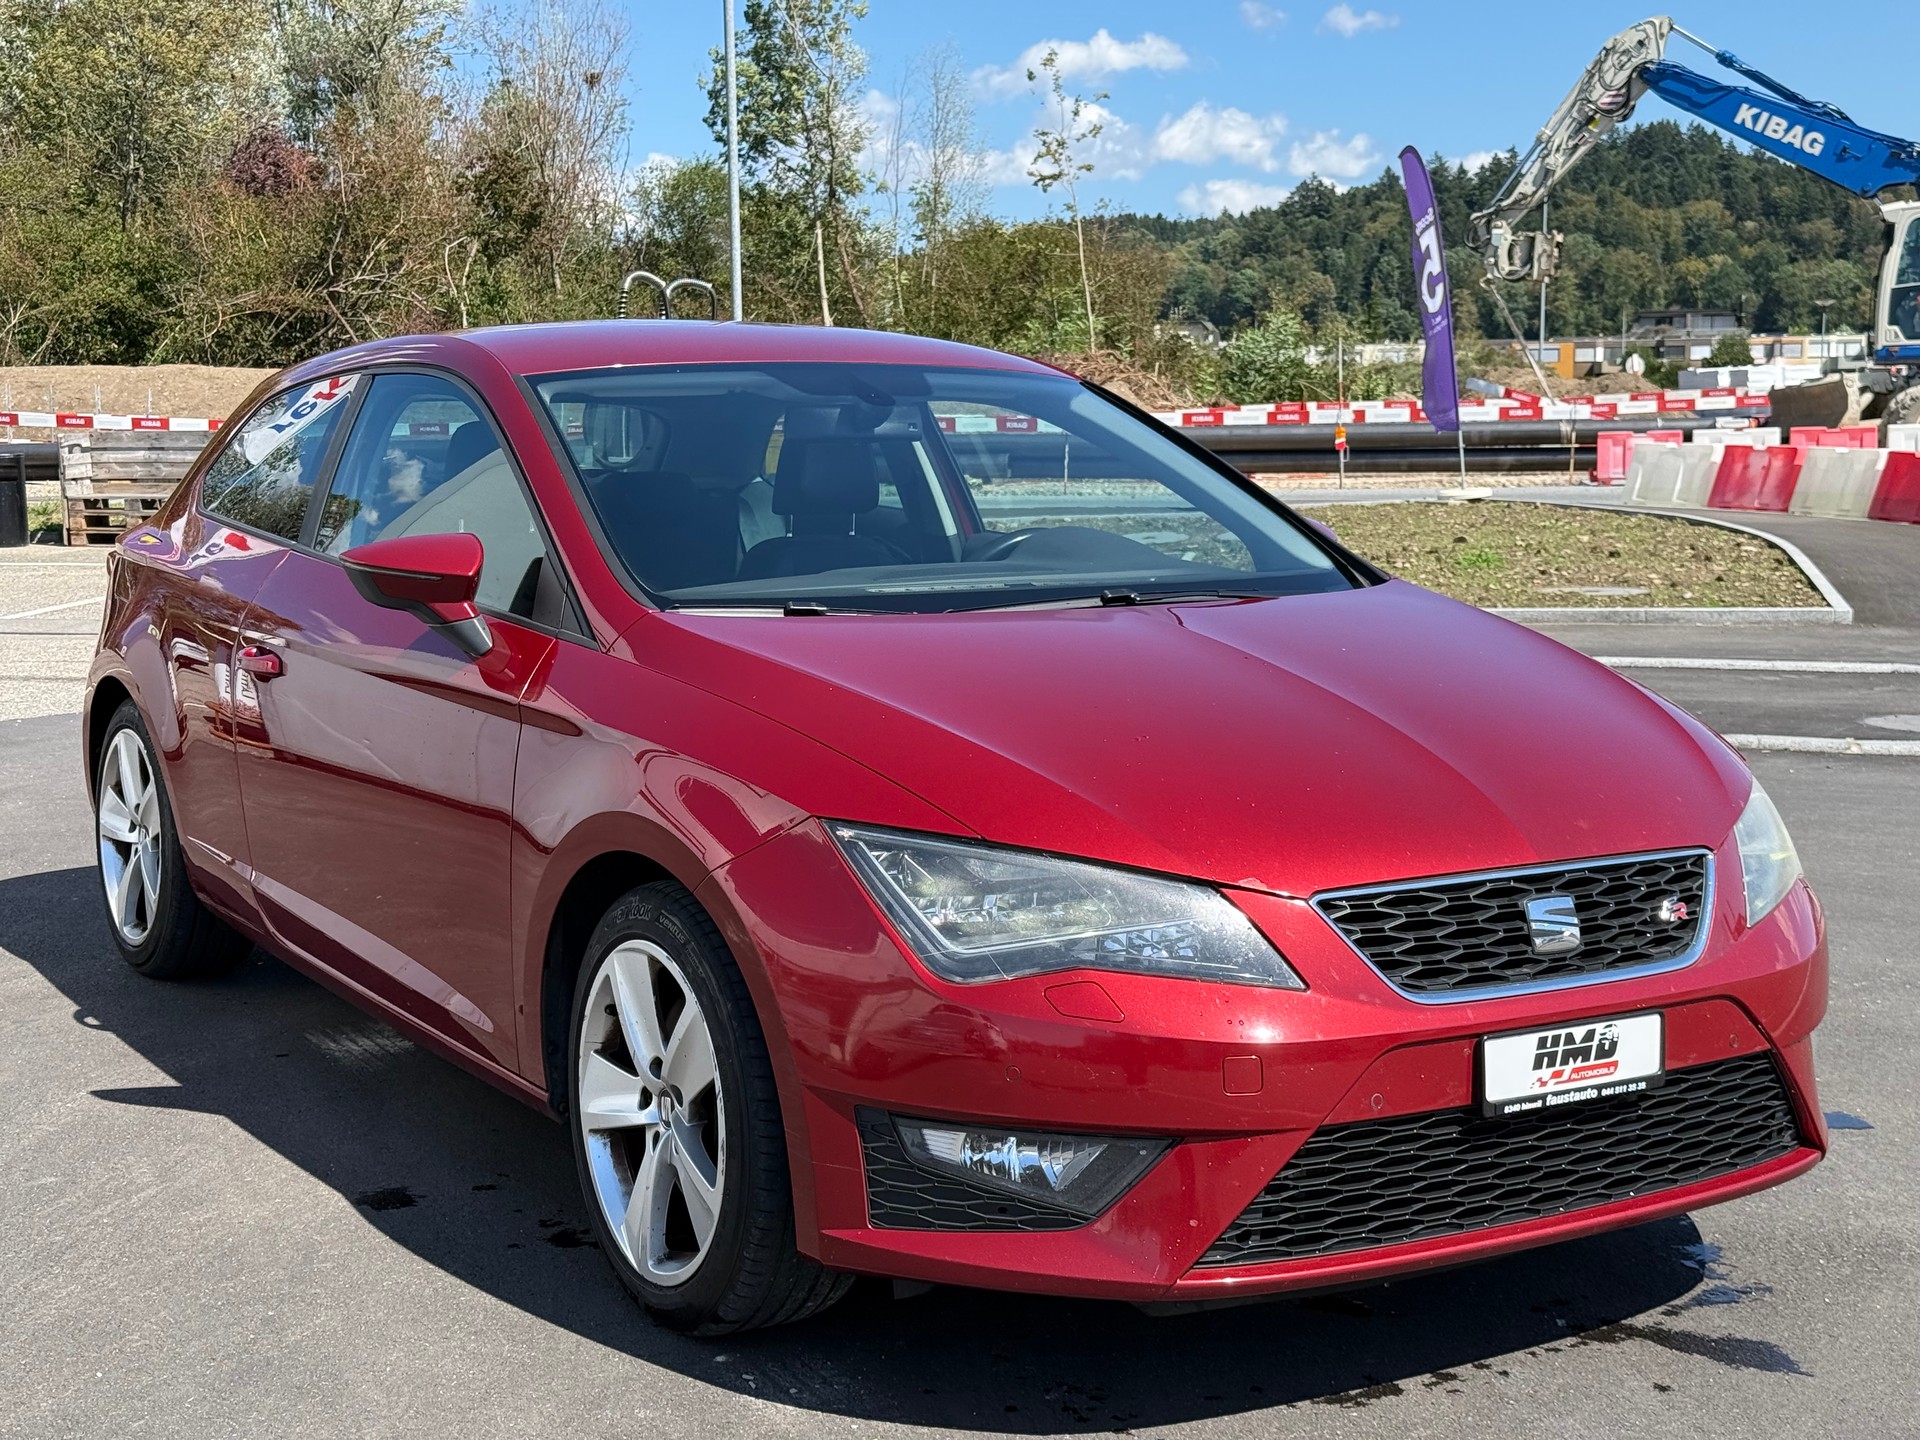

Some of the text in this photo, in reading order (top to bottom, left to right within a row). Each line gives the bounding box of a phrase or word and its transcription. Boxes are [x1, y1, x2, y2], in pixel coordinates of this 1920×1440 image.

[1733, 103, 1825, 157] KIBAG
[1570, 1066, 1616, 1080] AUTOMOBILE
[1546, 1087, 1599, 1107] faustauto
